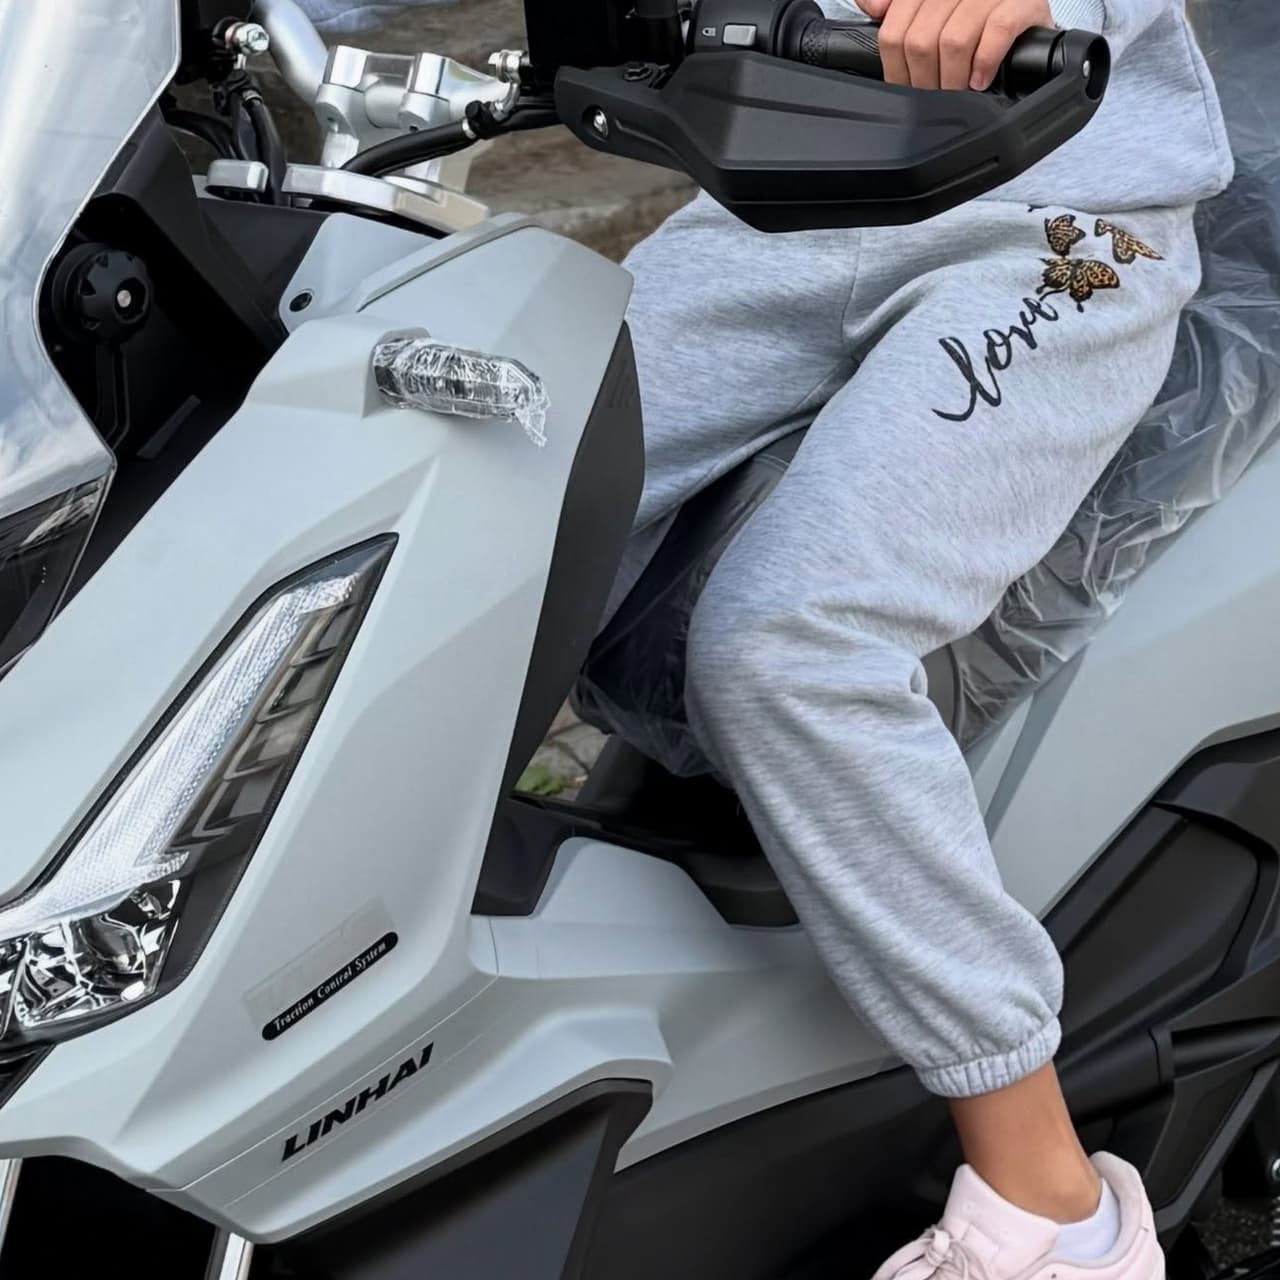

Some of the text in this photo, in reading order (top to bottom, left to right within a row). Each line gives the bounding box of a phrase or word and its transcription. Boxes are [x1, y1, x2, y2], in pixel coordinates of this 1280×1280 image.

[932, 296, 1060, 422] love
[273, 941, 387, 1032] Traction Control System
[281, 1041, 434, 1162] LINHAI
